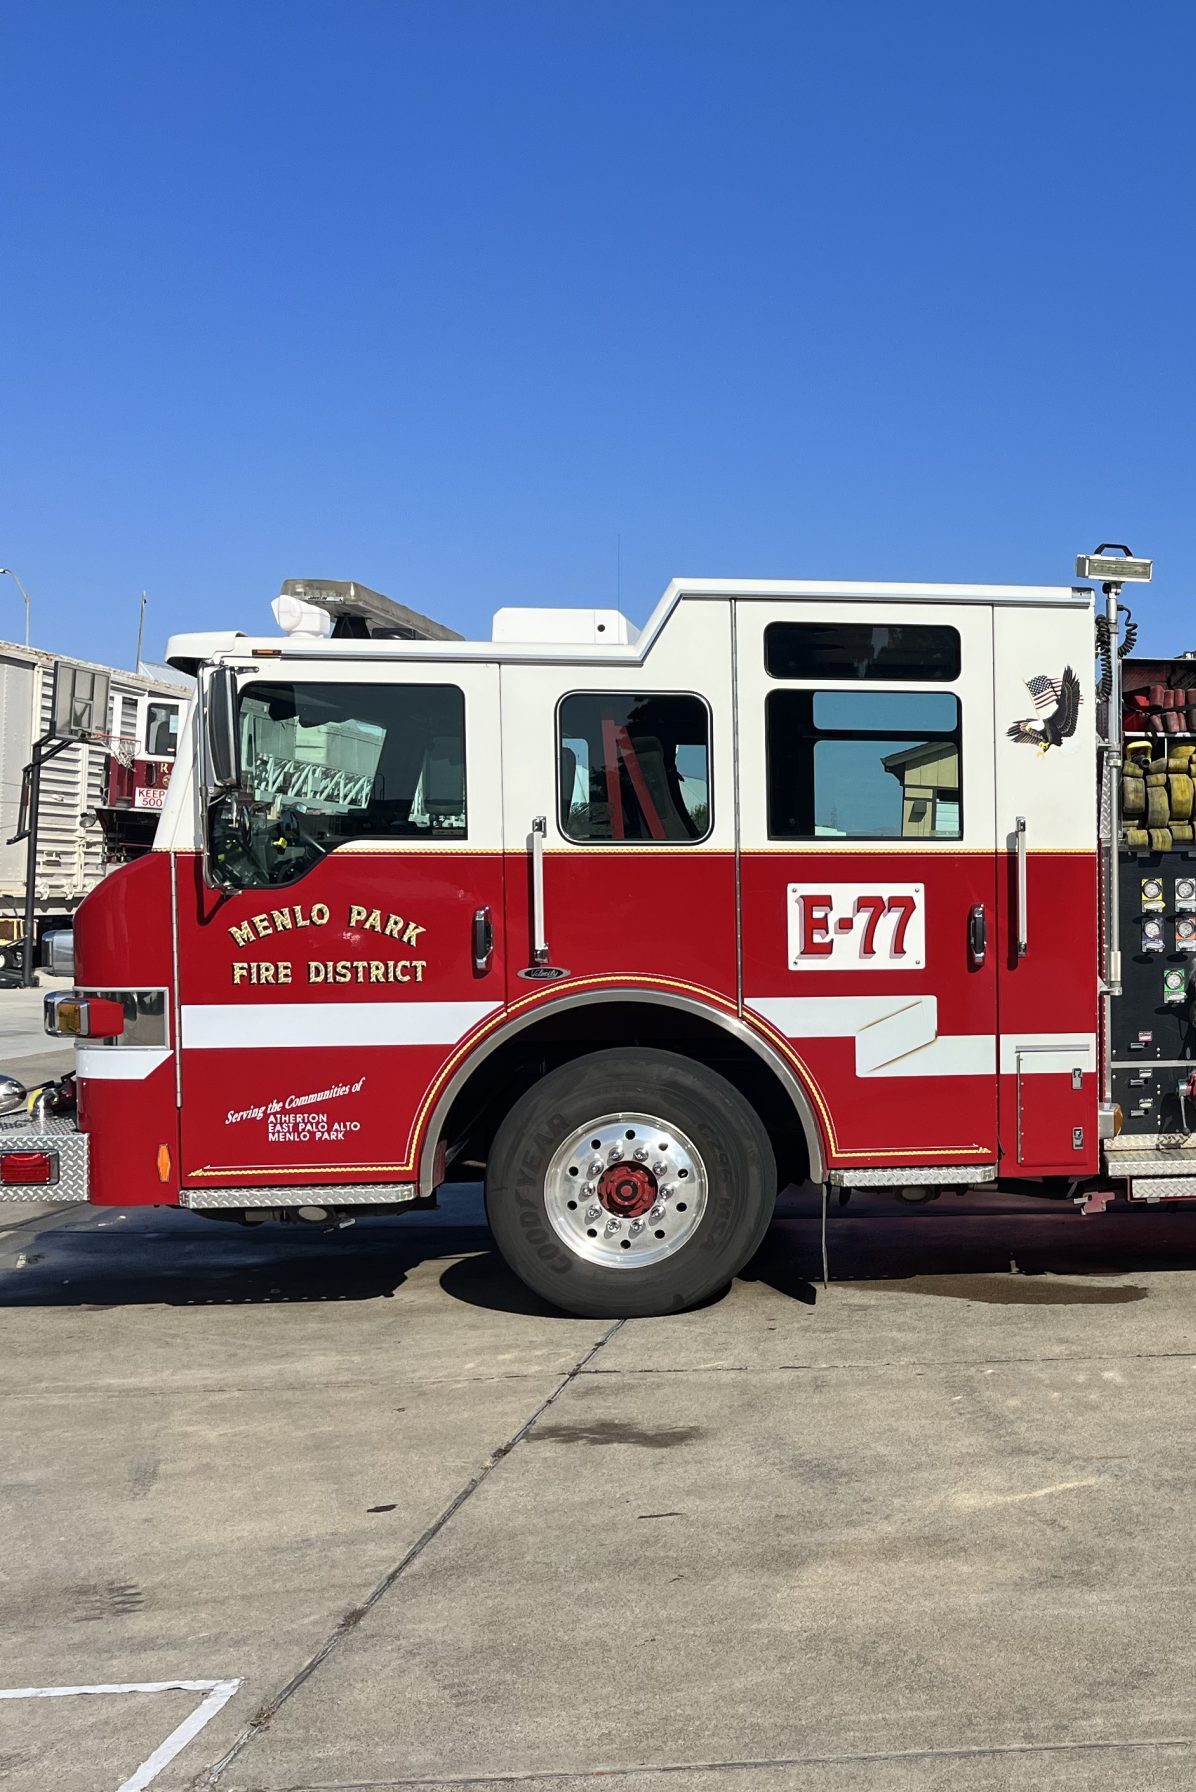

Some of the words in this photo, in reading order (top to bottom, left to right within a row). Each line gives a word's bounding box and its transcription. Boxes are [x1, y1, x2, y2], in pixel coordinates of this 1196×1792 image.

[138, 789, 165, 798] KEEP
[142, 798, 163, 807] 500
[228, 903, 330, 947] MENLO
[348, 904, 426, 947] PARK
[795, 895, 917, 959] E-77
[232, 961, 292, 984] FIRE
[307, 960, 427, 984] DISTRICT
[225, 1105, 266, 1124] Serving
[267, 1099, 283, 1114] the
[285, 1083, 350, 1109] Communities
[352, 1076, 366, 1093] of
[268, 1113, 327, 1123] ATHERTON
[268, 1123, 294, 1133] EAST
[299, 1122, 328, 1132] PALO
[333, 1121, 360, 1131] ALTO
[268, 1132, 310, 1142] MENLO
[315, 1131, 344, 1141] PARK
[515, 1113, 572, 1274] GOODYEAR
